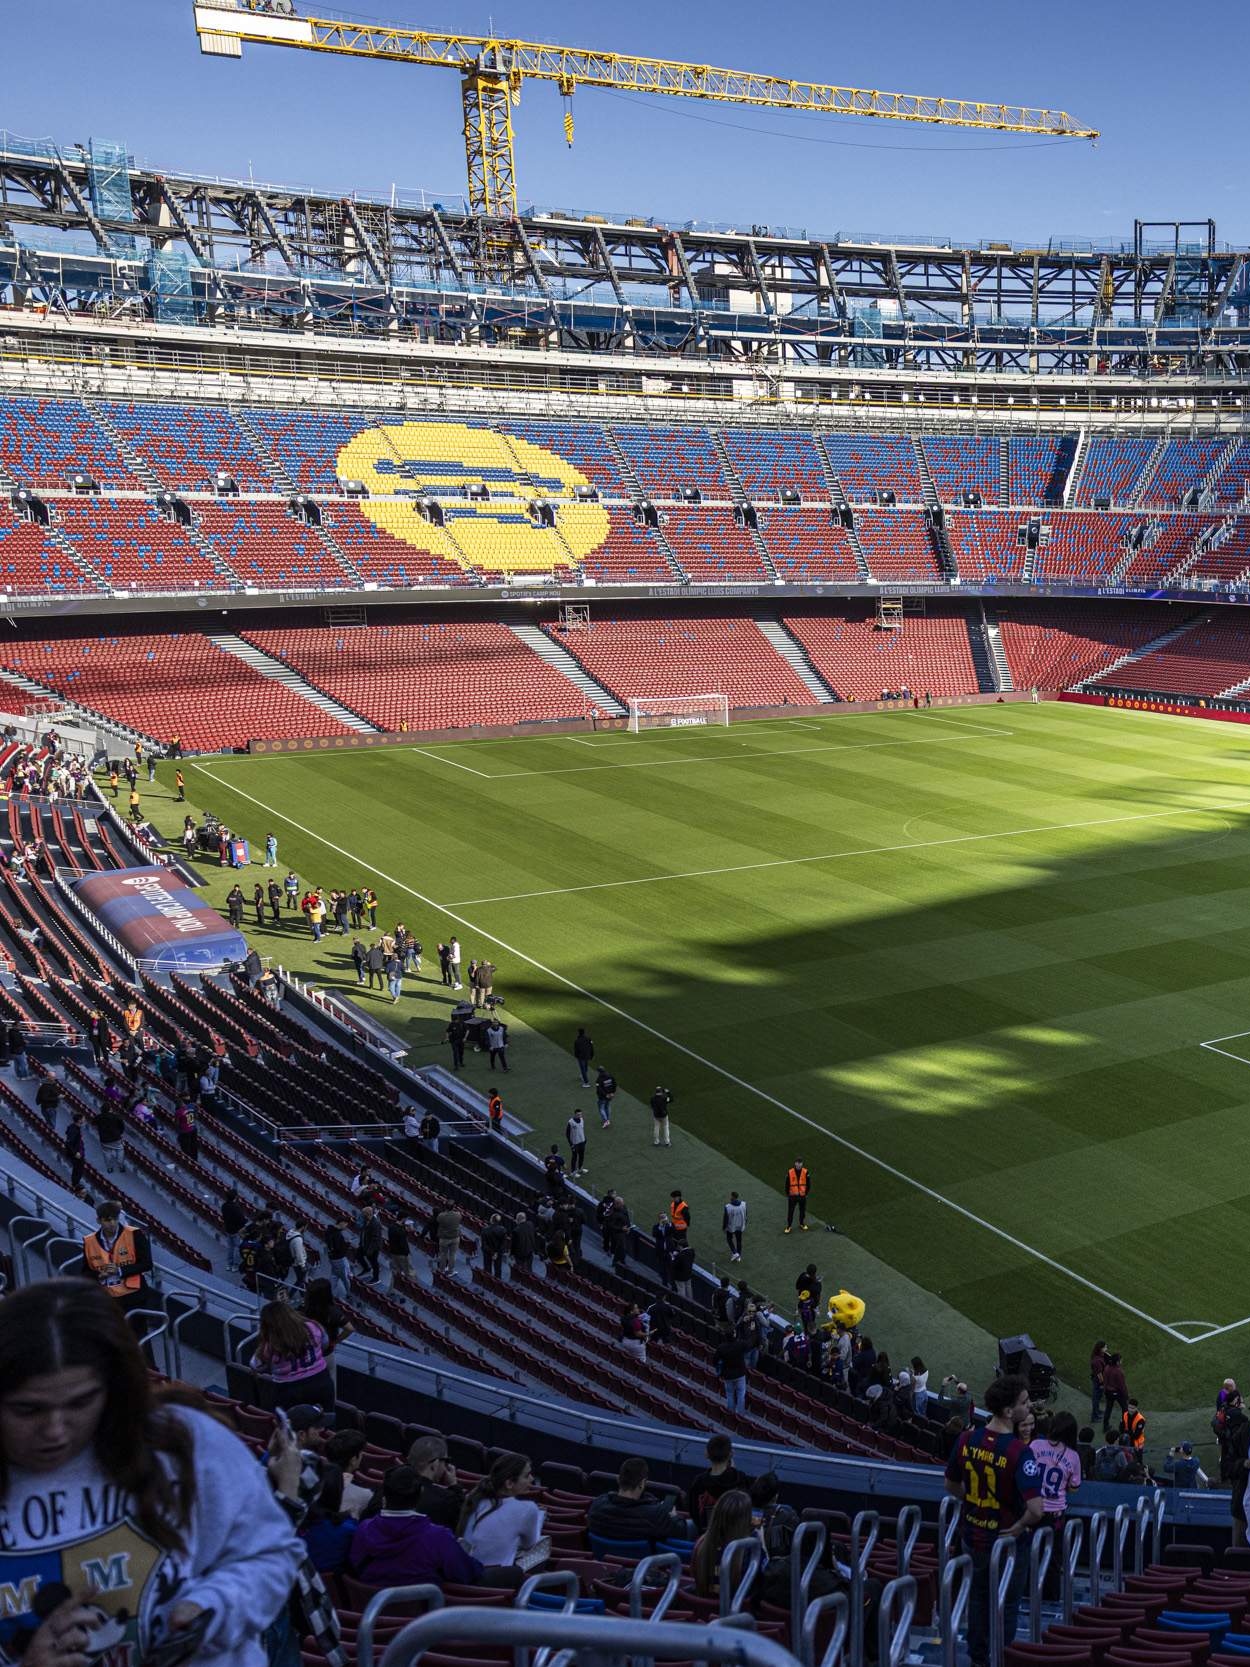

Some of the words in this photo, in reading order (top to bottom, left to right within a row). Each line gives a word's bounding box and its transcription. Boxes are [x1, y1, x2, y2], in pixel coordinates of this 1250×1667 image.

[134, 883, 177, 905] SPOTIFY
[155, 902, 193, 918] CAMP
[170, 917, 208, 932] NOU
[995, 1455, 1008, 1470] JR
[1037, 1462, 1064, 1498] 19
[964, 1460, 1001, 1511] 11
[24, 1491, 66, 1540] OF
[80, 1552, 134, 1594] M
[0, 1574, 43, 1618] M
